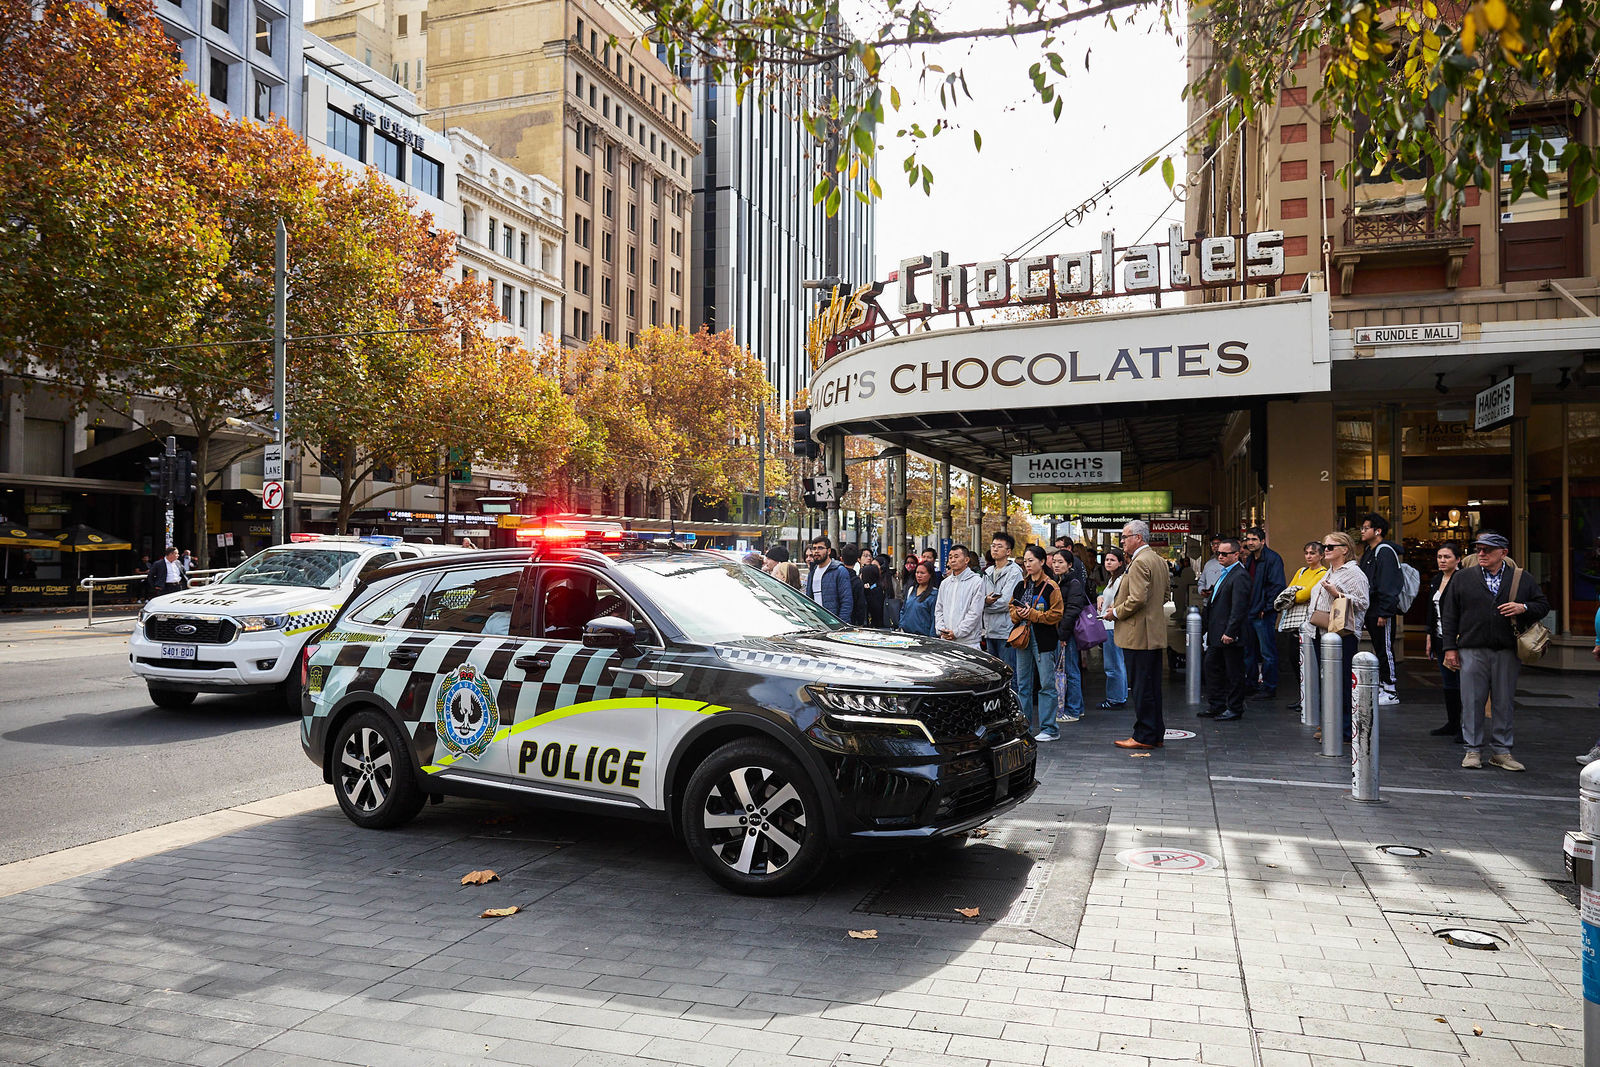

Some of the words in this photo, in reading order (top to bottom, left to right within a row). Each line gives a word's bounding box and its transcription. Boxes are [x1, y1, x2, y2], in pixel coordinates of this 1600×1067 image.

[899, 223, 1284, 315] Chocolates
[1375, 330, 1418, 342] RUNDLE
[1424, 328, 1454, 339] MALL
[890, 340, 1251, 395] CHOCOLATES
[1478, 383, 1511, 415] HAIGH'S
[1477, 404, 1510, 425] CHOCOLATES
[265, 466, 281, 475] LANE
[1029, 457, 1103, 471] HAIGH'S
[1029, 470, 1103, 479] CHOCOLATES
[1320, 470, 1329, 482] 2
[1152, 523, 1190, 531] MASSAGE
[170, 598, 239, 607] POLICE
[451, 733, 478, 746] POLICE
[518, 740, 647, 788] POLICE
[1573, 847, 1593, 856] SERVICE
